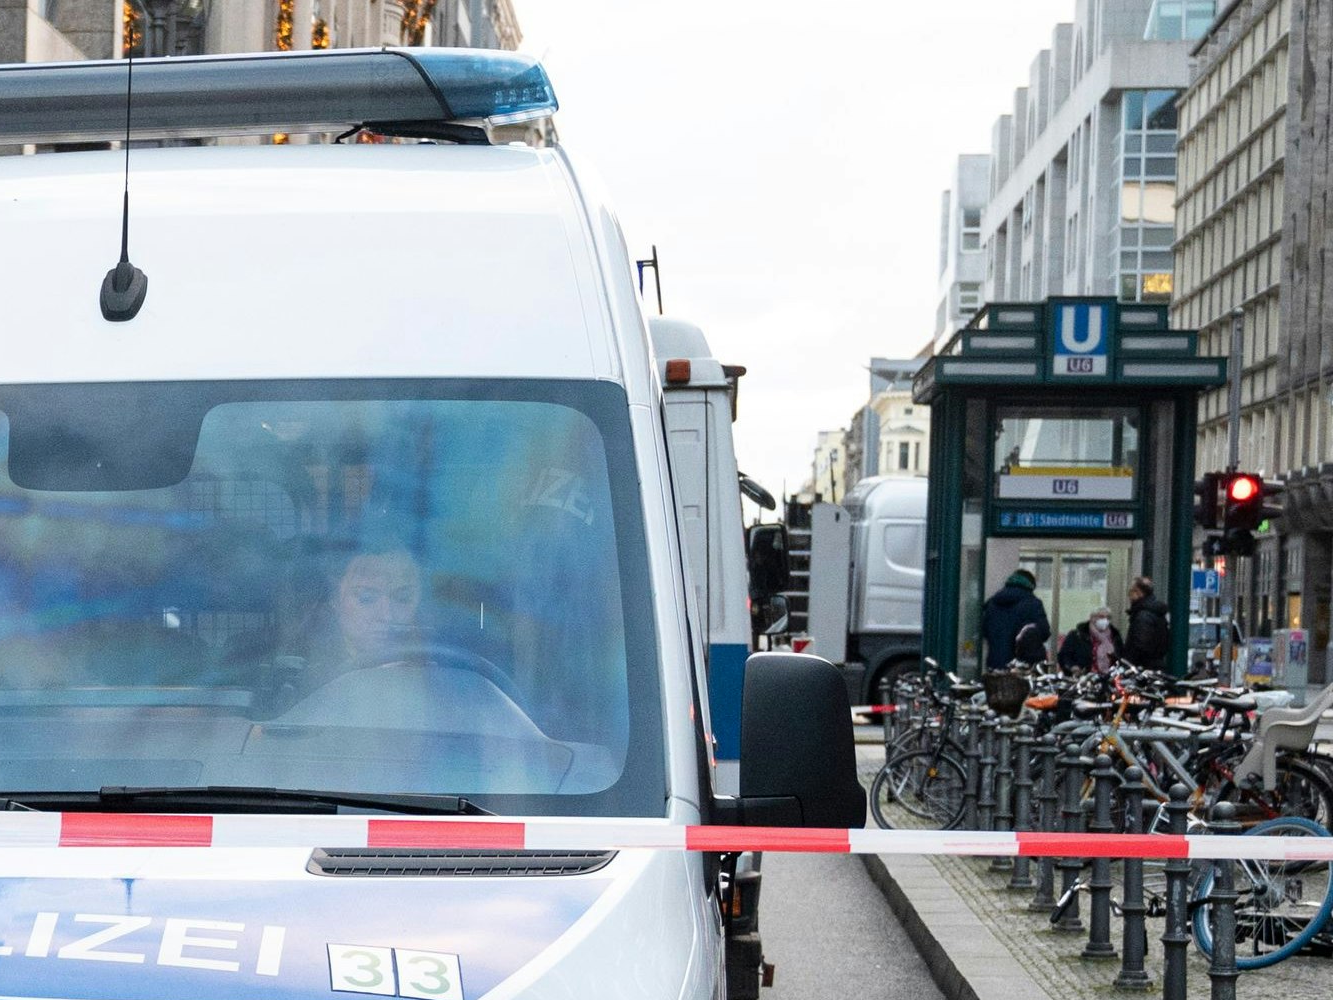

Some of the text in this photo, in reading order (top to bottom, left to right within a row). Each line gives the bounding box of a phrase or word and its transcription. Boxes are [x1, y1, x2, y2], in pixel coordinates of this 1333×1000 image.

[1061, 306, 1102, 353] U
[1069, 358, 1092, 373] U6
[1055, 480, 1077, 494] U6
[1040, 513, 1101, 527] Stadtmitte
[1107, 513, 1127, 526] U6
[340, 949, 451, 995] 33
